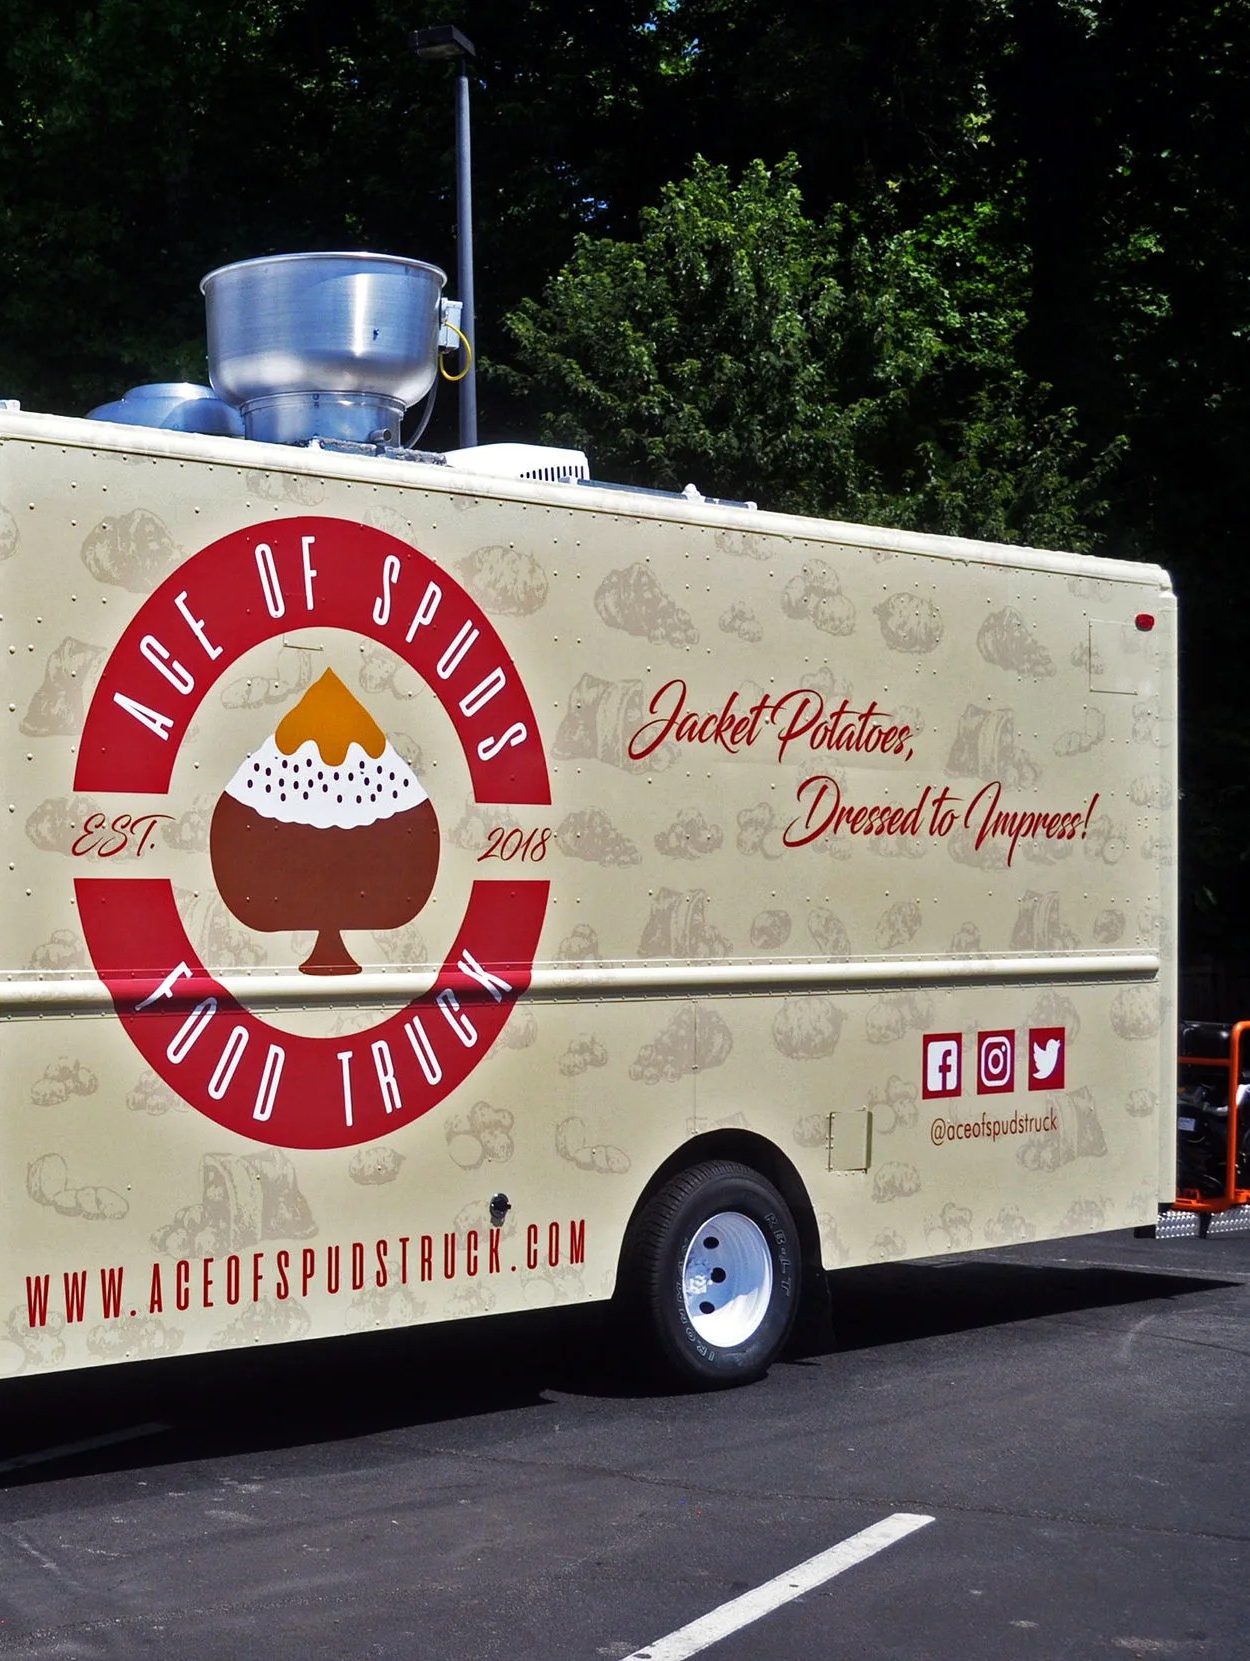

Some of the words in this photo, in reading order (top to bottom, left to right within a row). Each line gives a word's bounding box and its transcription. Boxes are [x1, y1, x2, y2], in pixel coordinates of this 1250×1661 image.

[113, 590, 223, 741] ACE
[254, 535, 317, 619] OF
[372, 554, 528, 761] SPUDS
[628, 679, 786, 760] Jacket
[770, 688, 914, 763] Potatoes,
[71, 813, 176, 857] EST.
[477, 827, 552, 862] 2018
[783, 775, 932, 848] Dressed
[929, 786, 965, 836] to
[964, 781, 1100, 867] Impress!
[134, 961, 286, 1122] FOOD
[337, 949, 513, 1126] TRUCK
[930, 1107, 1058, 1146] @aceofspudstruck
[26, 1219, 587, 1328] WWW.ACEOFSPUDSTRUCK.COM
